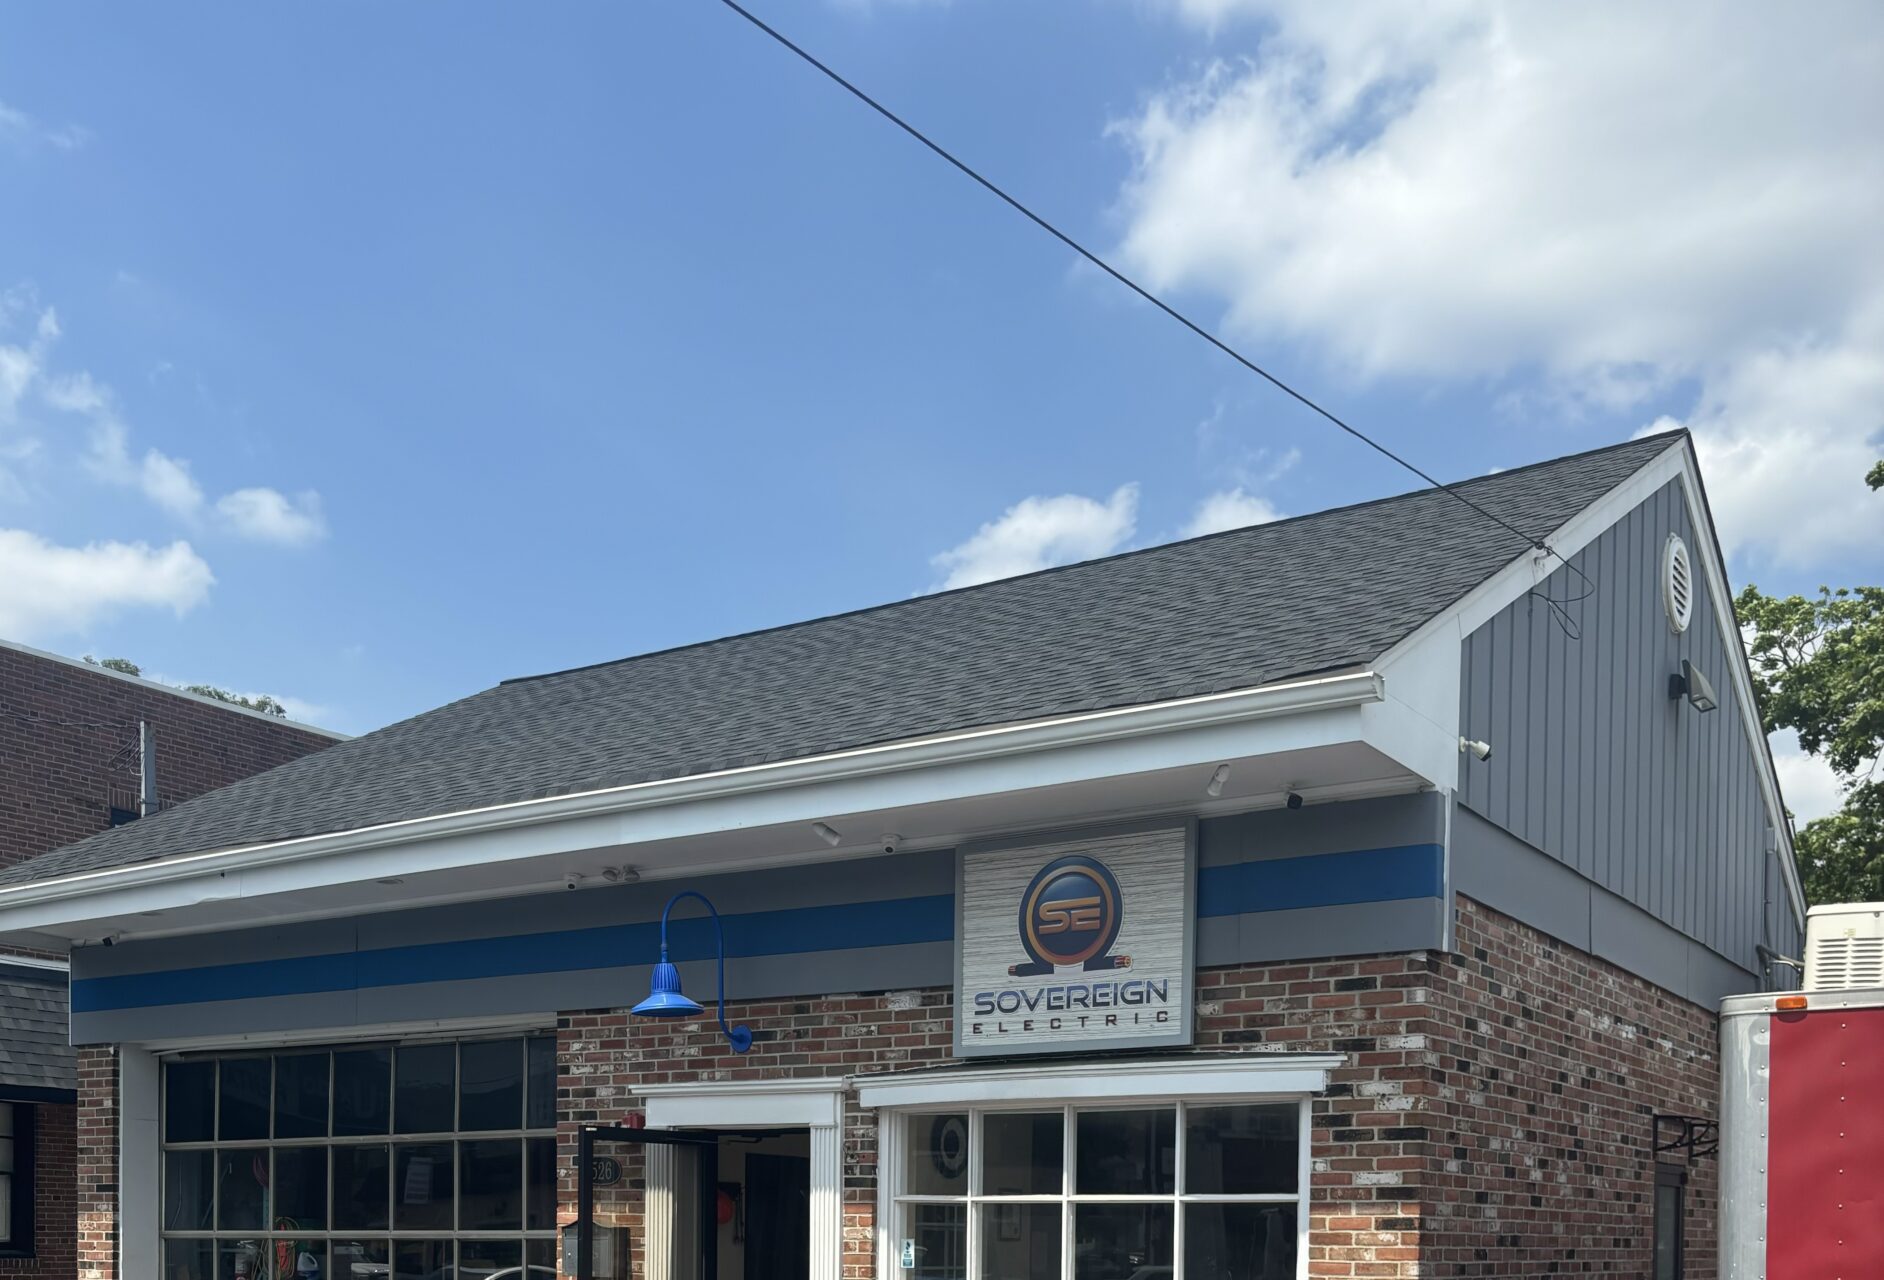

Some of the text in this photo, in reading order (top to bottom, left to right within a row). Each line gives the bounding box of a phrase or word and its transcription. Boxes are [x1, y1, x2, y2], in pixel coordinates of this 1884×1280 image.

[1039, 896, 1101, 935] SE
[974, 978, 1168, 1015] SOVEREIGN
[972, 1011, 1168, 1034] ELECTRIC
